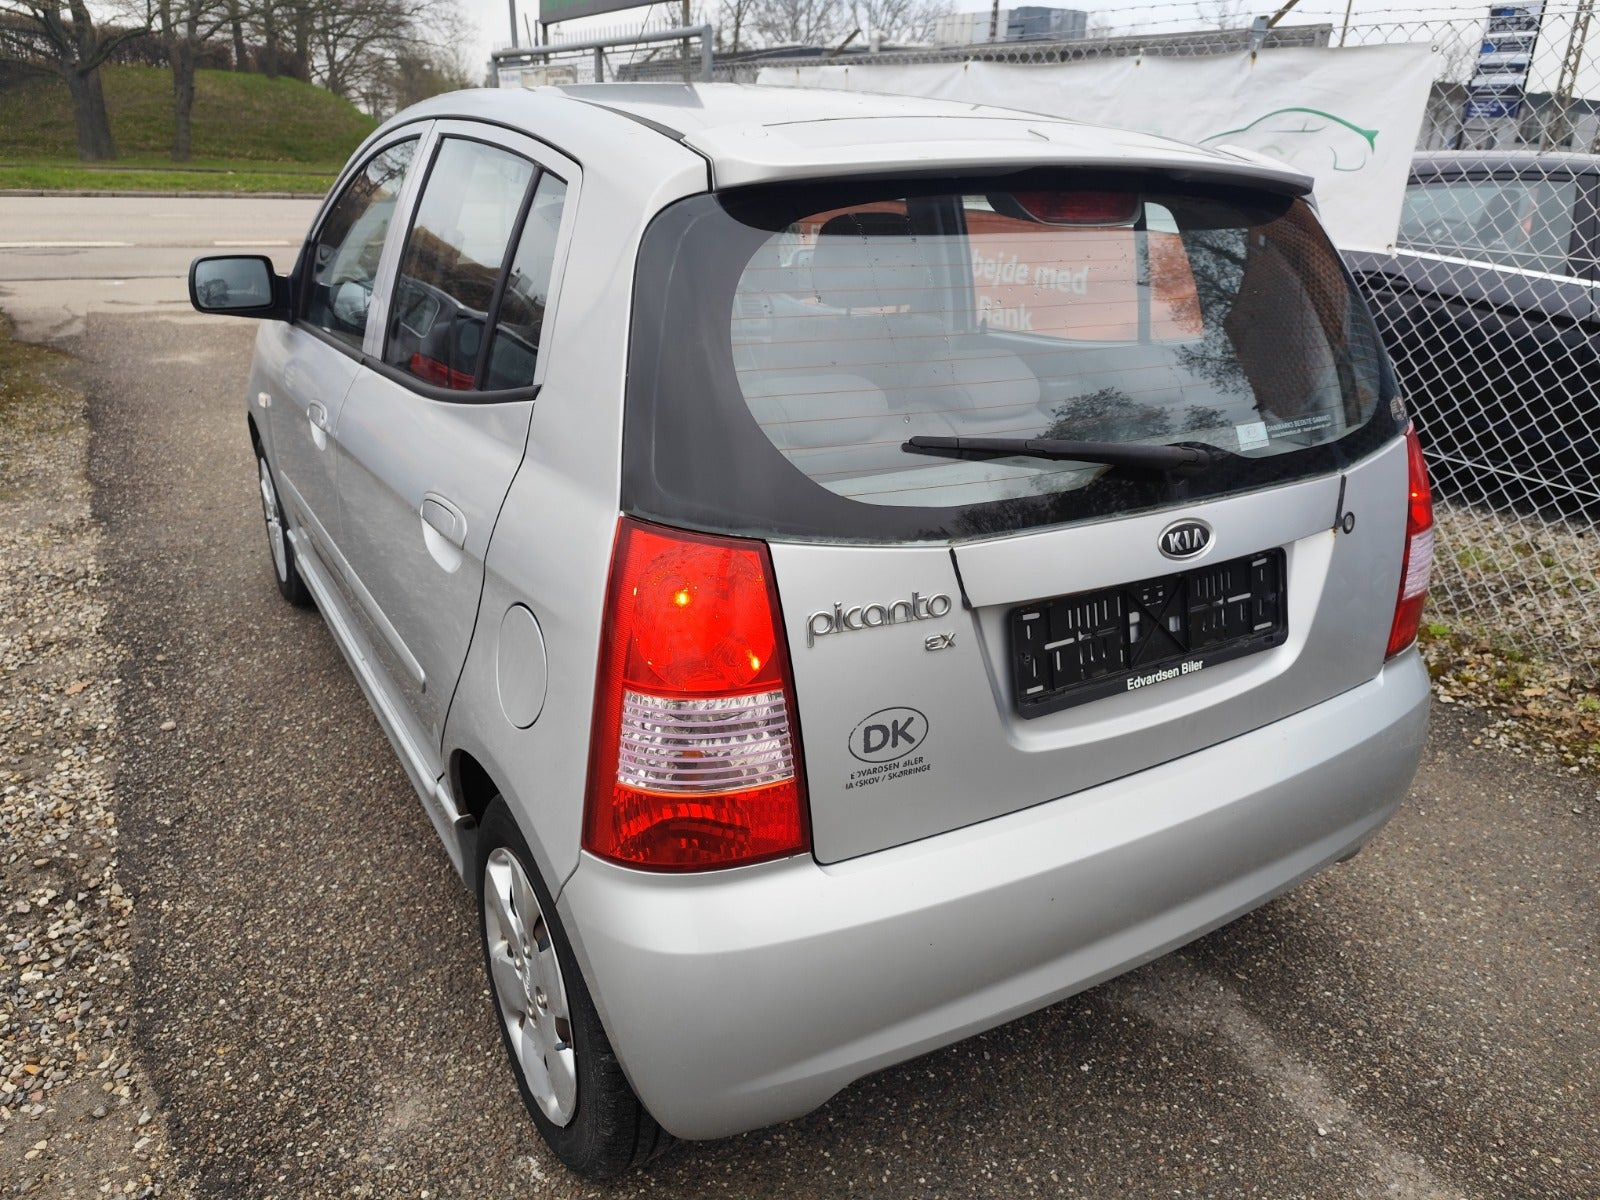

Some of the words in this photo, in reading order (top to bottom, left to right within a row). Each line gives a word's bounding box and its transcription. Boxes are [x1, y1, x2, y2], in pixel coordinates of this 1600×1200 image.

[1035, 265, 1089, 295] med
[1168, 527, 1205, 552] KIA
[806, 591, 952, 648] picanto
[924, 632, 956, 651] EX
[1126, 667, 1180, 690] Edvardsen
[1181, 660, 1204, 677] Biler
[863, 716, 915, 754] DK
